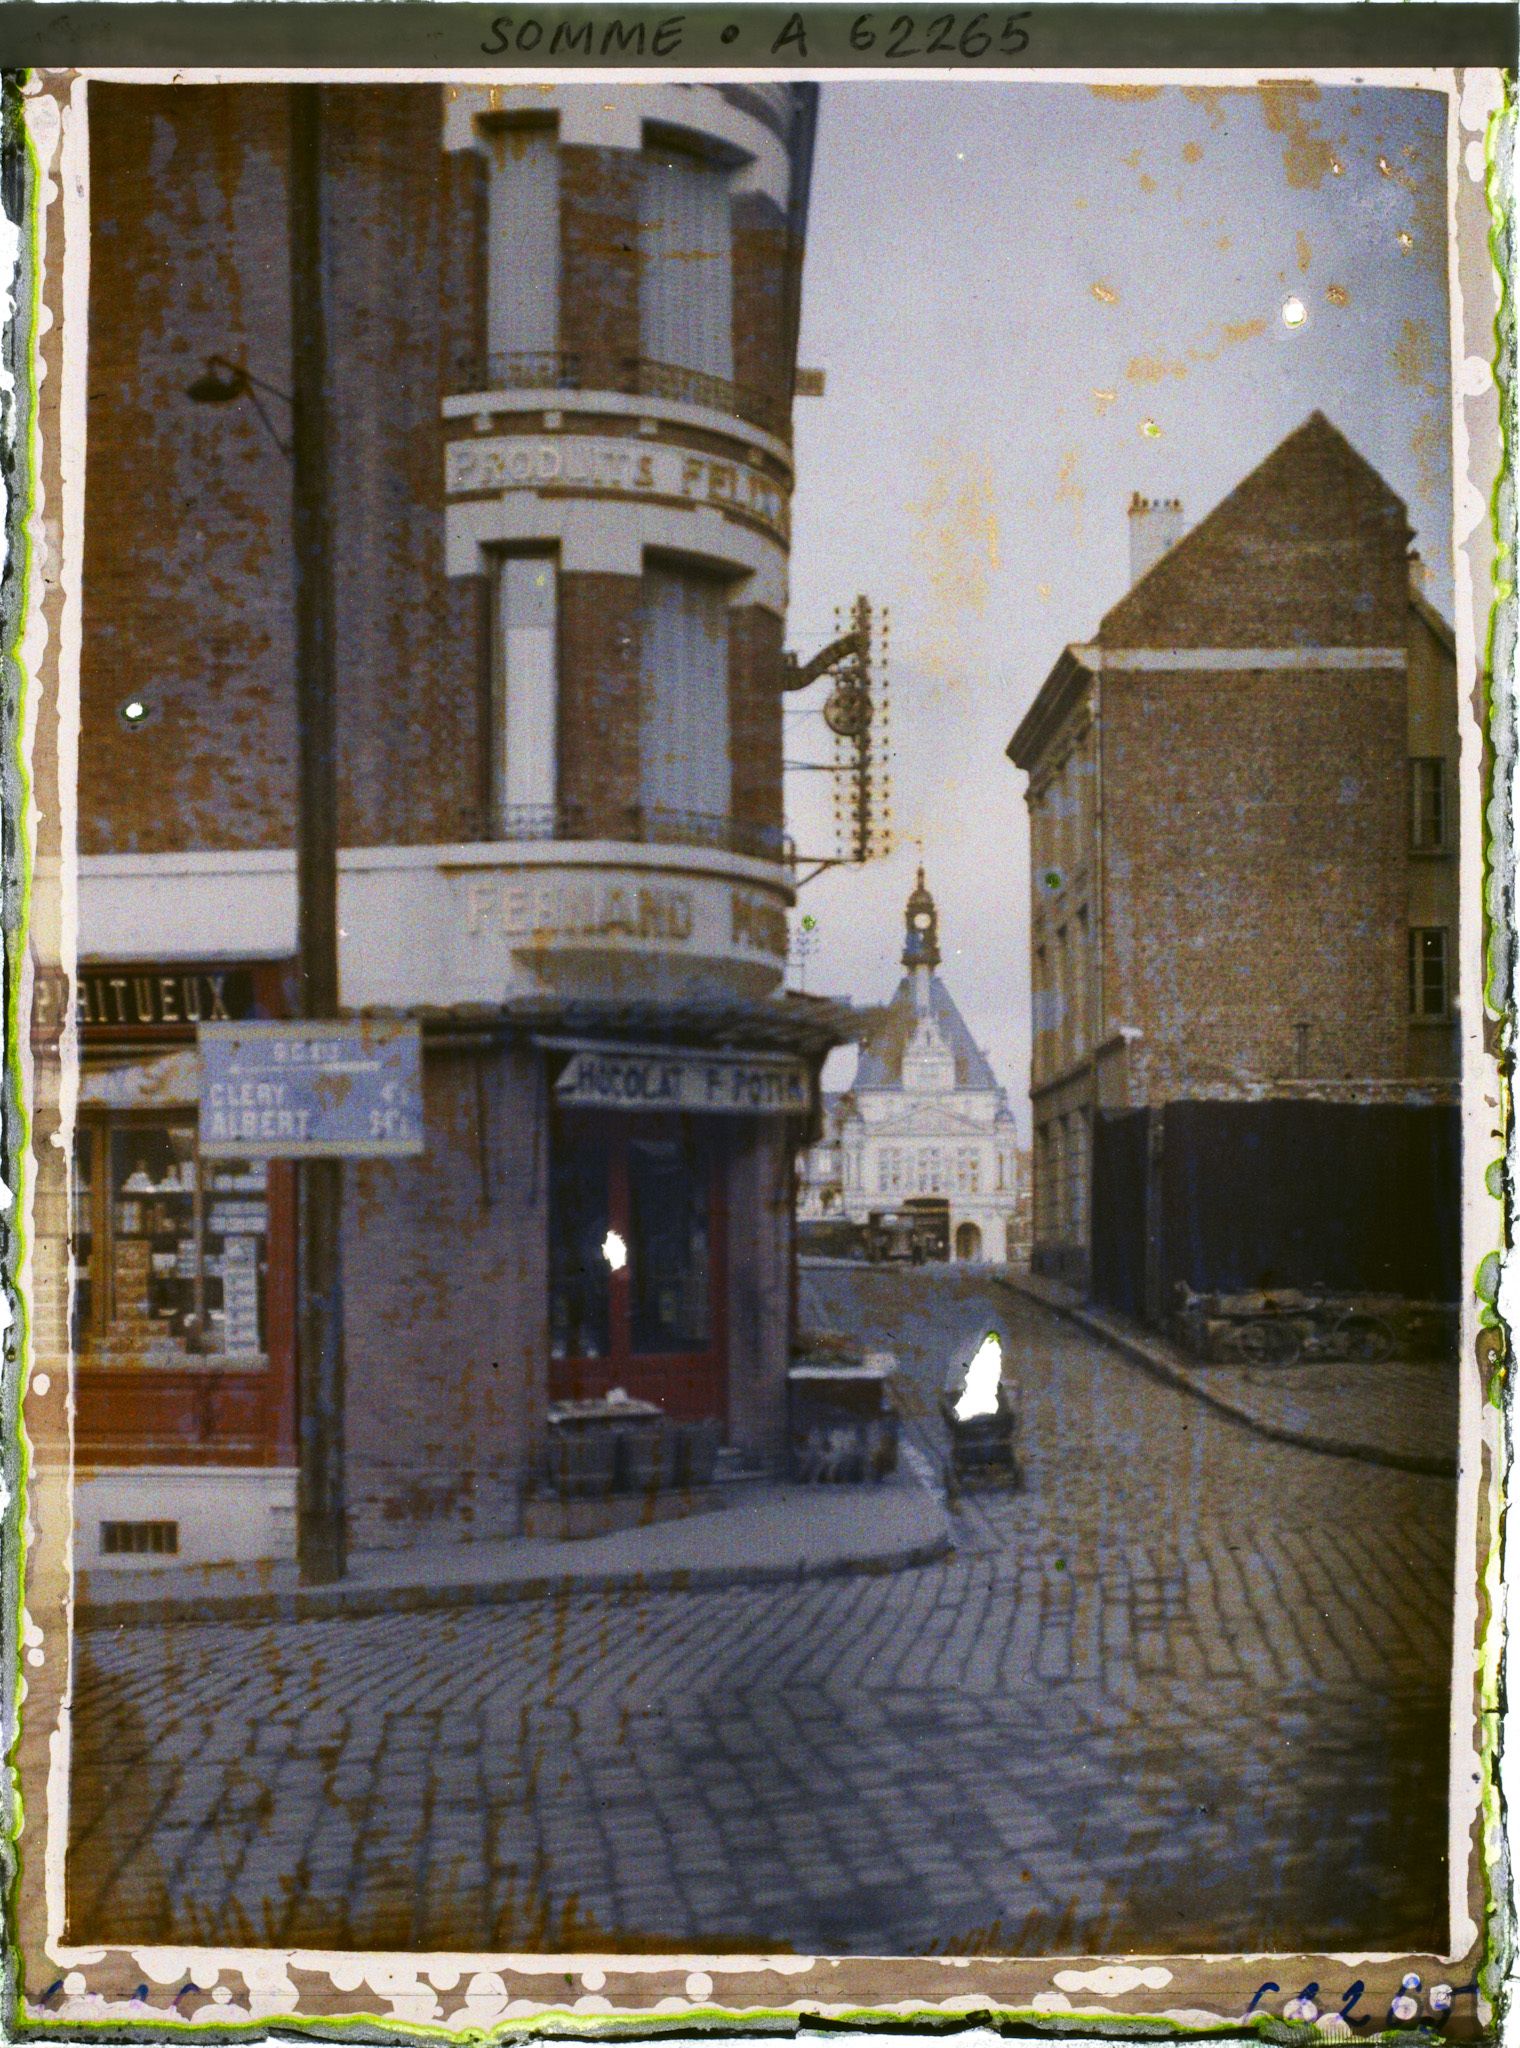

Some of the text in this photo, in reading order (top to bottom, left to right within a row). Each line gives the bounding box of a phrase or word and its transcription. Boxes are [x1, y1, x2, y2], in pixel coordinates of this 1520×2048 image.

[480, 12, 1034, 59] SOMME A 62265
[210, 1108, 310, 1137] ALBERT
